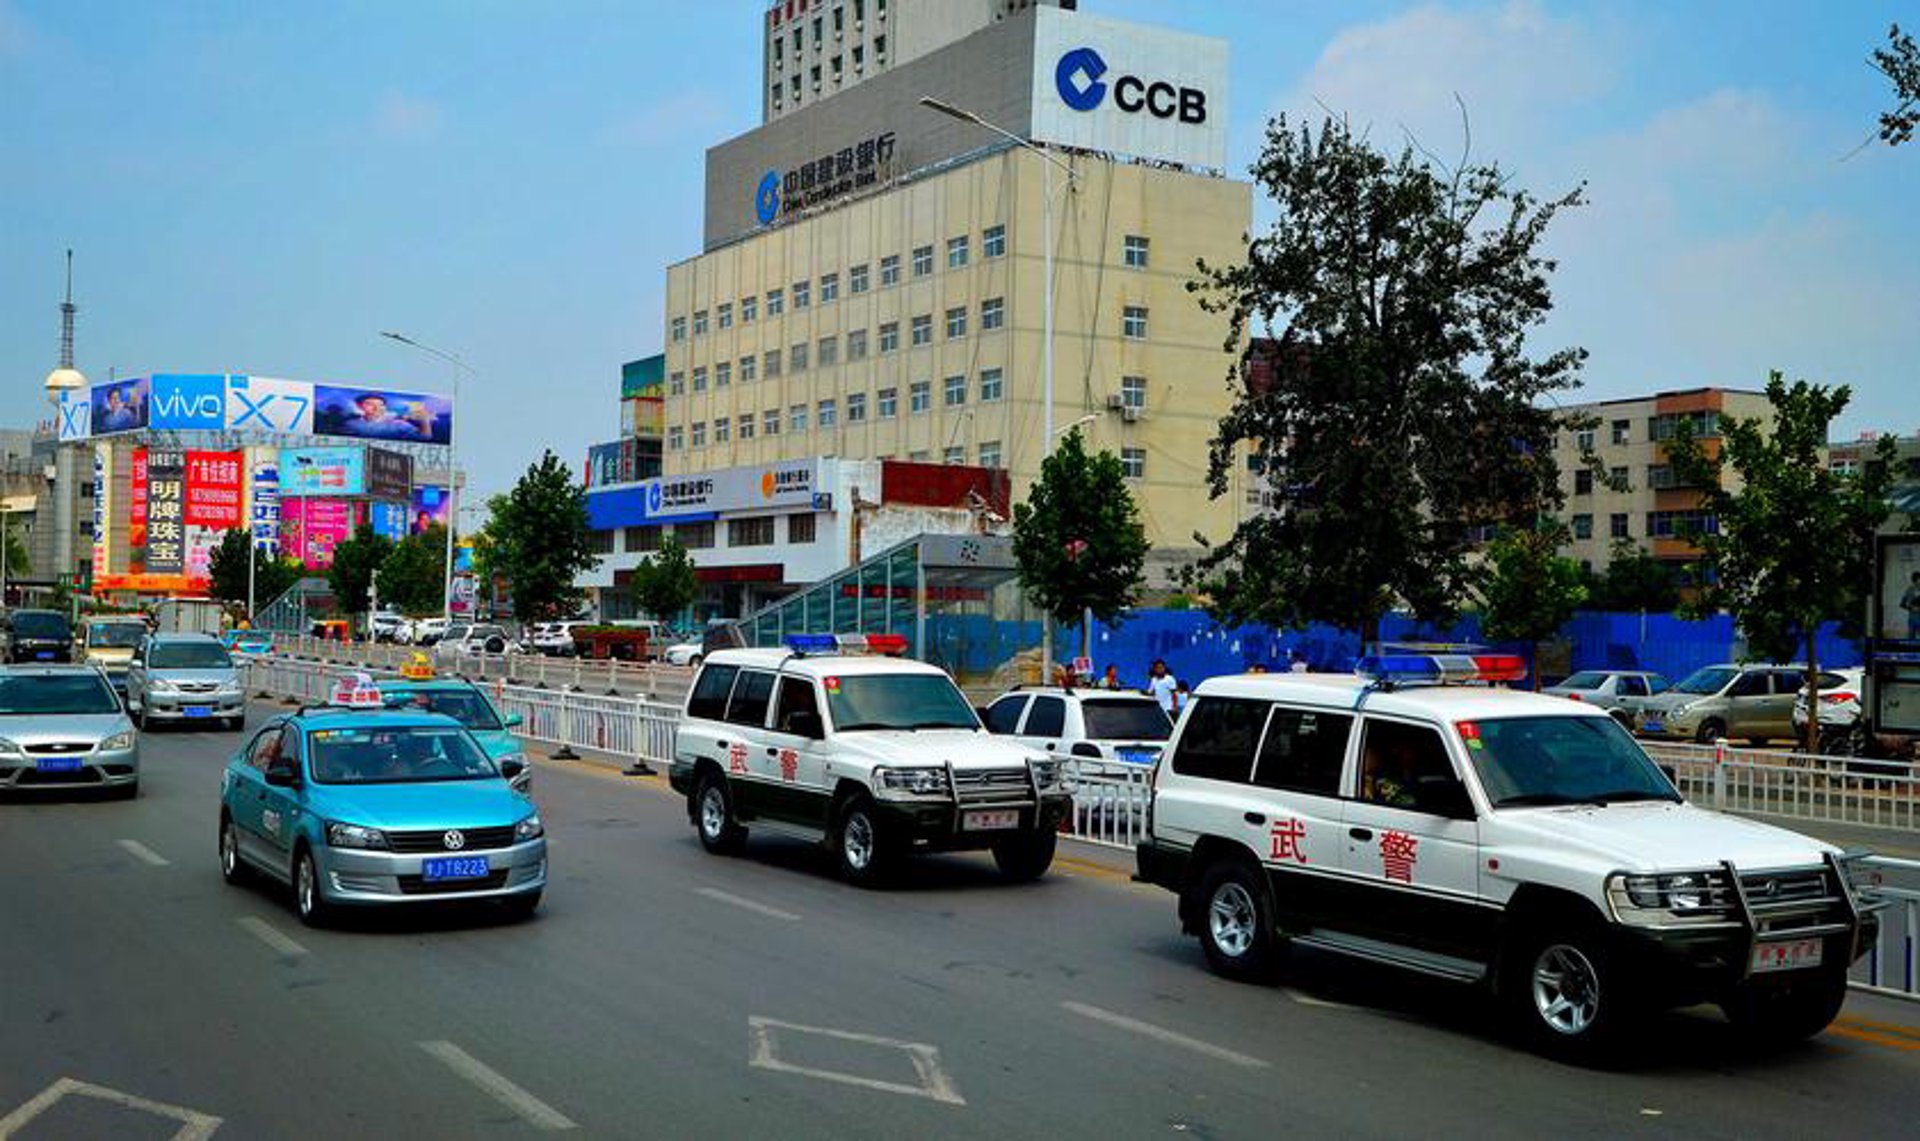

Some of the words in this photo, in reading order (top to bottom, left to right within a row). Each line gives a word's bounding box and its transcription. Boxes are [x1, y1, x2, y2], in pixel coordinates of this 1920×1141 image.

[1114, 75, 1206, 124] CCB
[783, 131, 896, 194] 中国建设银行
[61, 401, 90, 438] X7
[154, 388, 221, 418] vivo
[233, 391, 308, 430] X7
[150, 480, 181, 561] 明牌珠宝
